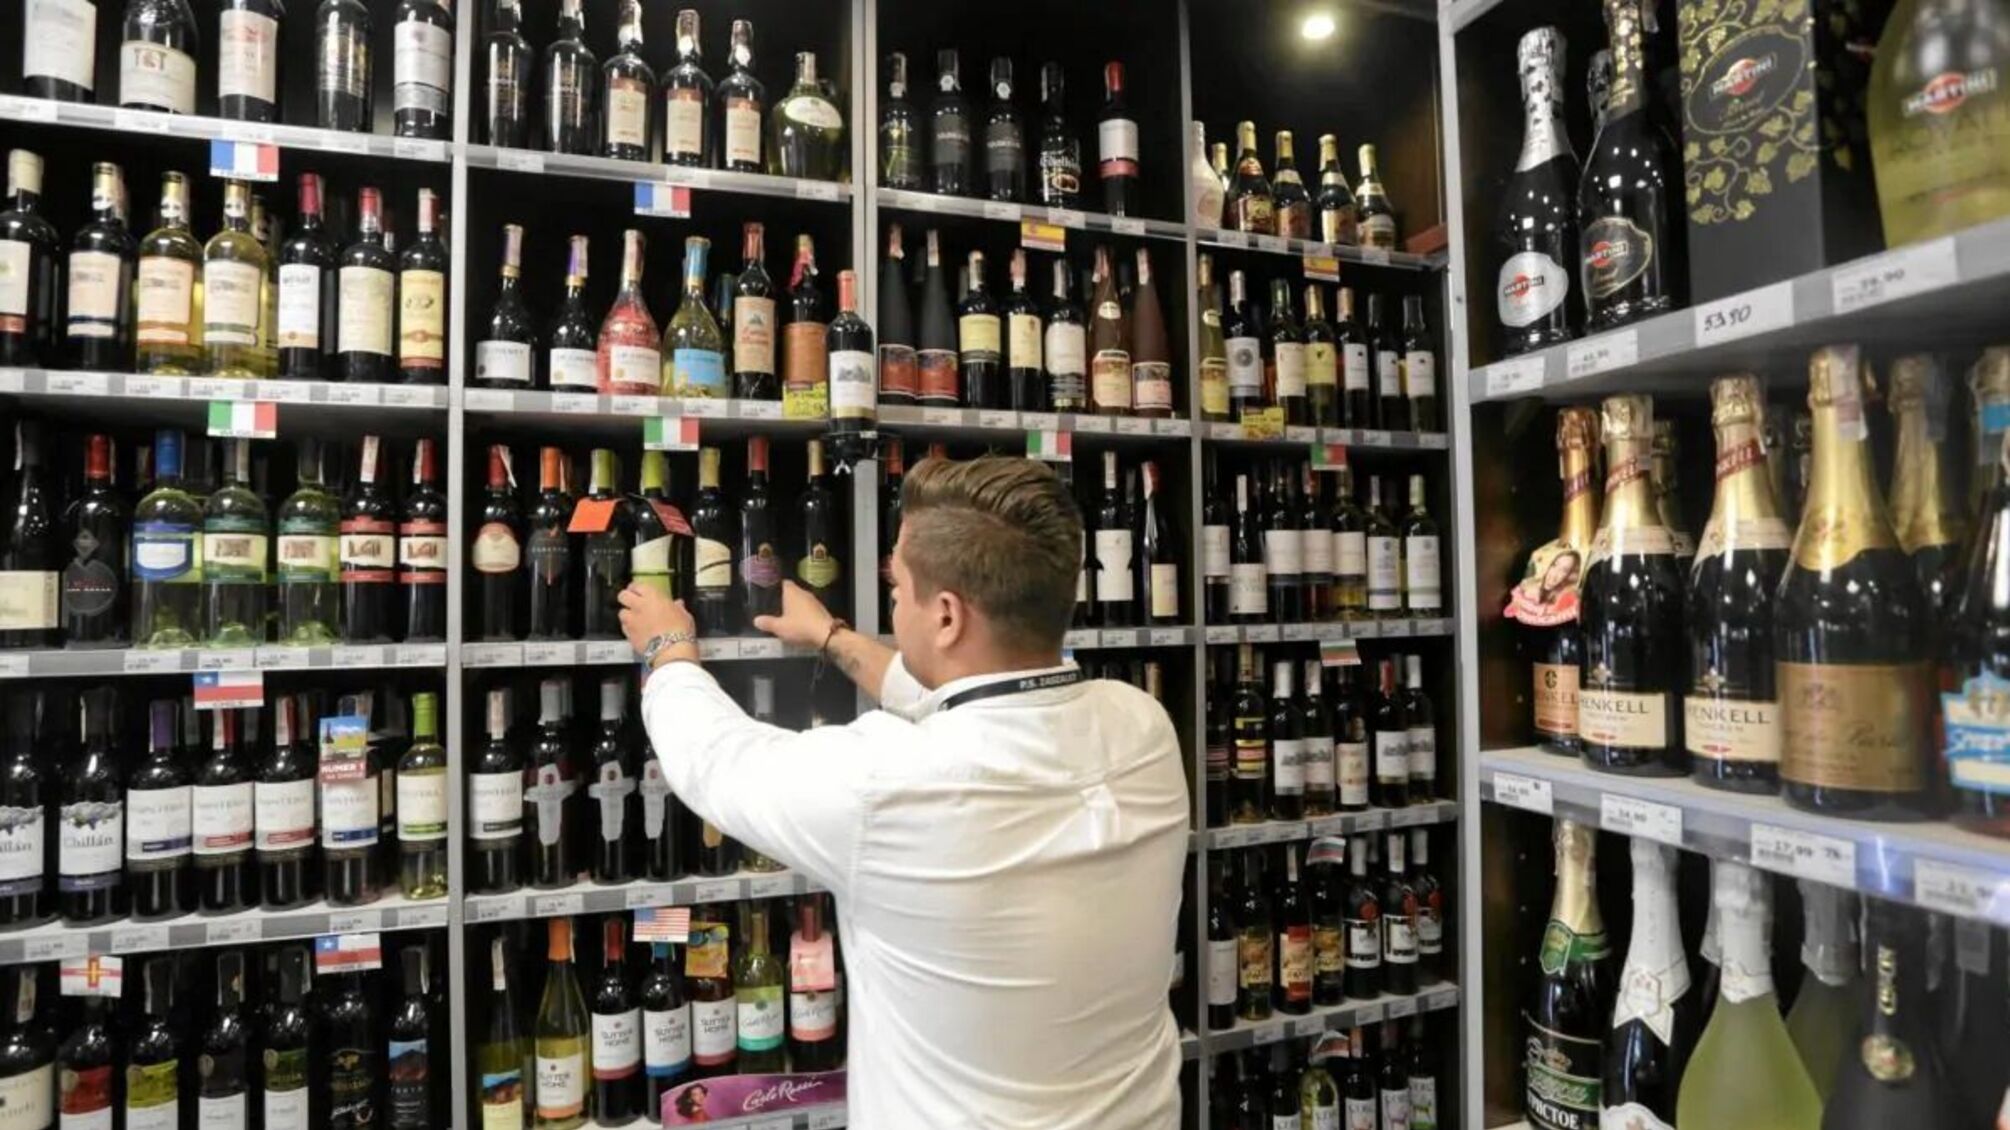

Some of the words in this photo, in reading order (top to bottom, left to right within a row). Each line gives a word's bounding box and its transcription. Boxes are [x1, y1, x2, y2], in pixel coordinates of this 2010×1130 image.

[1711, 53, 1776, 98] MARTINI
[1903, 67, 1998, 118] MARTINI
[1584, 241, 1630, 264] MARTINI
[1504, 275, 1545, 298] MARTINI
